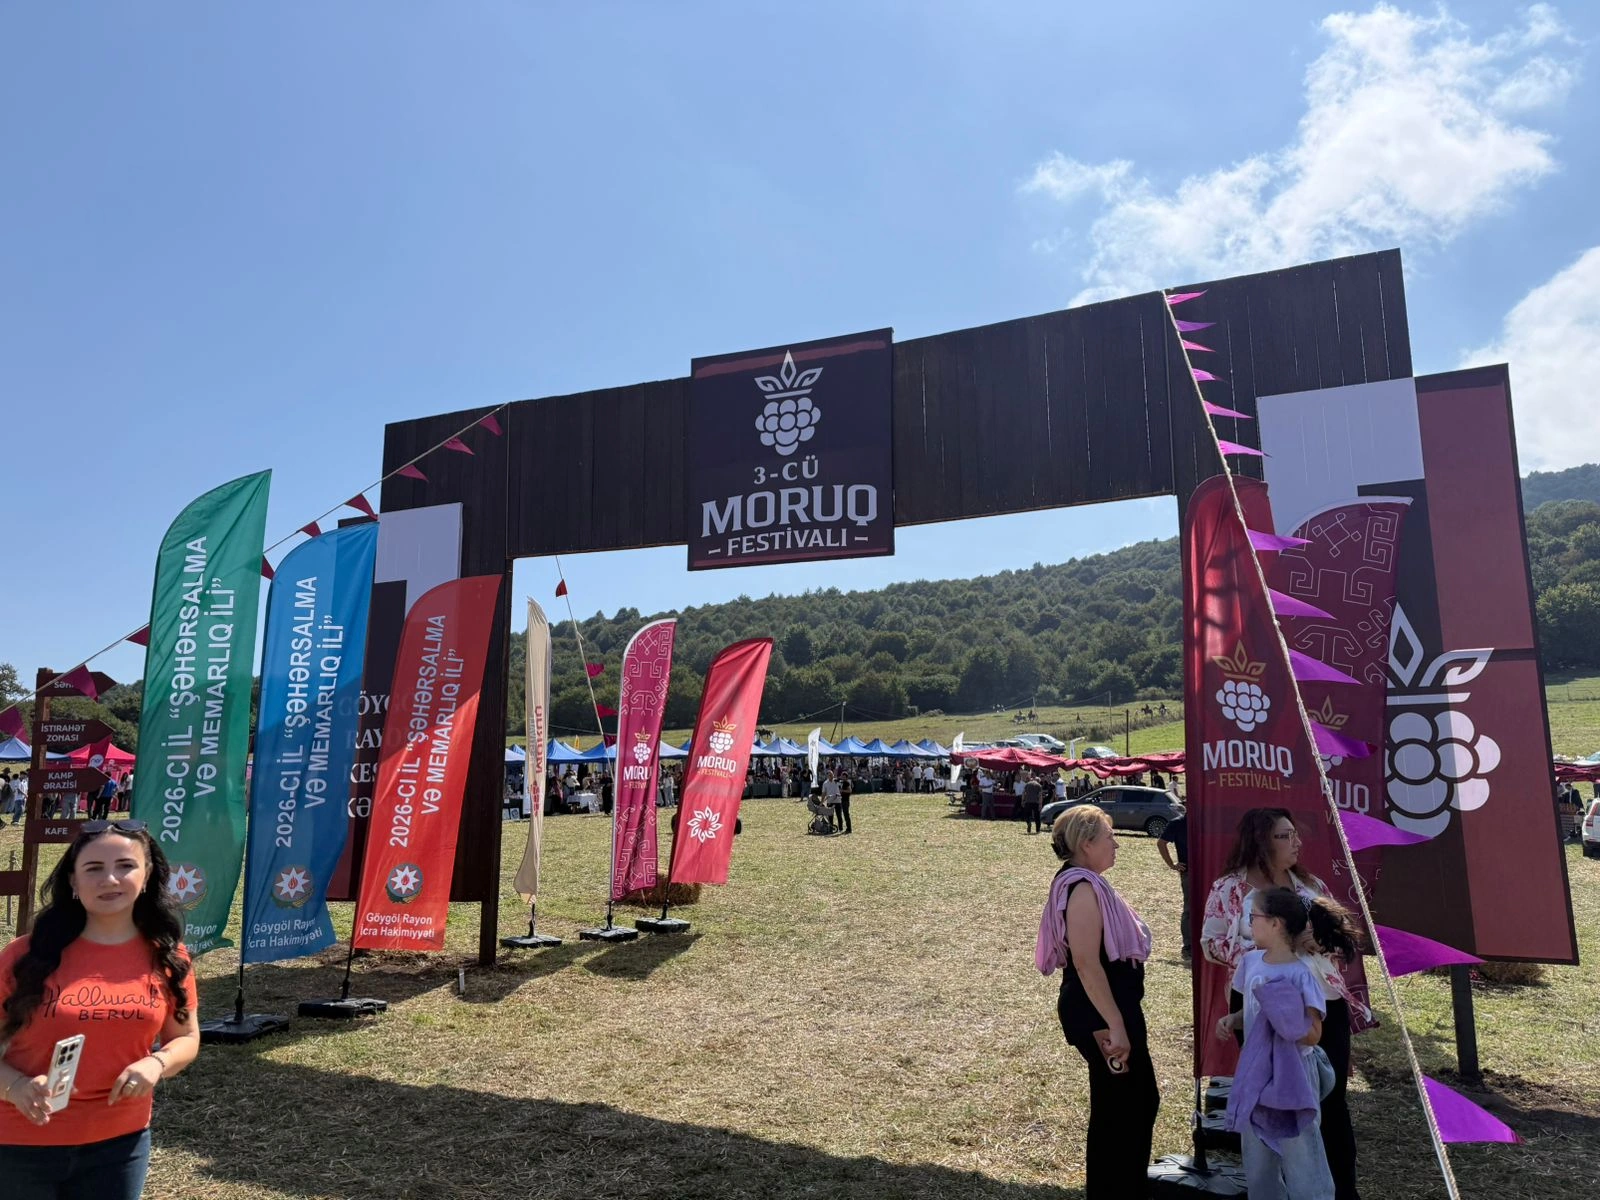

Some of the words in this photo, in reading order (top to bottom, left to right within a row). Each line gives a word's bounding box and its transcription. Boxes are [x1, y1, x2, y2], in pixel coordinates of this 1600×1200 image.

[754, 455, 819, 484] 3-CÜ
[701, 484, 878, 538] MORUQ
[200, 623, 234, 755] MEMARLIQ
[308, 655, 341, 771] MEMARLIQ
[46, 734, 79, 742] ZONASI
[161, 725, 193, 747] İL
[425, 683, 461, 783] MEMARLIQ
[276, 745, 303, 764] İL
[396, 757, 420, 773] İL
[697, 755, 737, 773] MORUQ
[1202, 739, 1294, 778] MORUQ
[48, 772, 74, 780] KAMP
[193, 762, 217, 798] VƏ
[623, 765, 652, 781] MORU
[160, 755, 191, 842] 2026-CI
[304, 778, 327, 809] VƏ
[420, 788, 442, 814] VƏ
[275, 770, 302, 848] 2026-CI
[389, 779, 417, 848] 2026-CI
[44, 827, 68, 835] KAFE
[253, 920, 291, 935] Göygöl
[366, 912, 400, 925] Göygöl
[402, 913, 433, 926] Rayon
[380, 927, 435, 940] Hakimiyyəti
[44, 984, 161, 1018] Hallmark
[78, 1009, 145, 1021] BERUL
